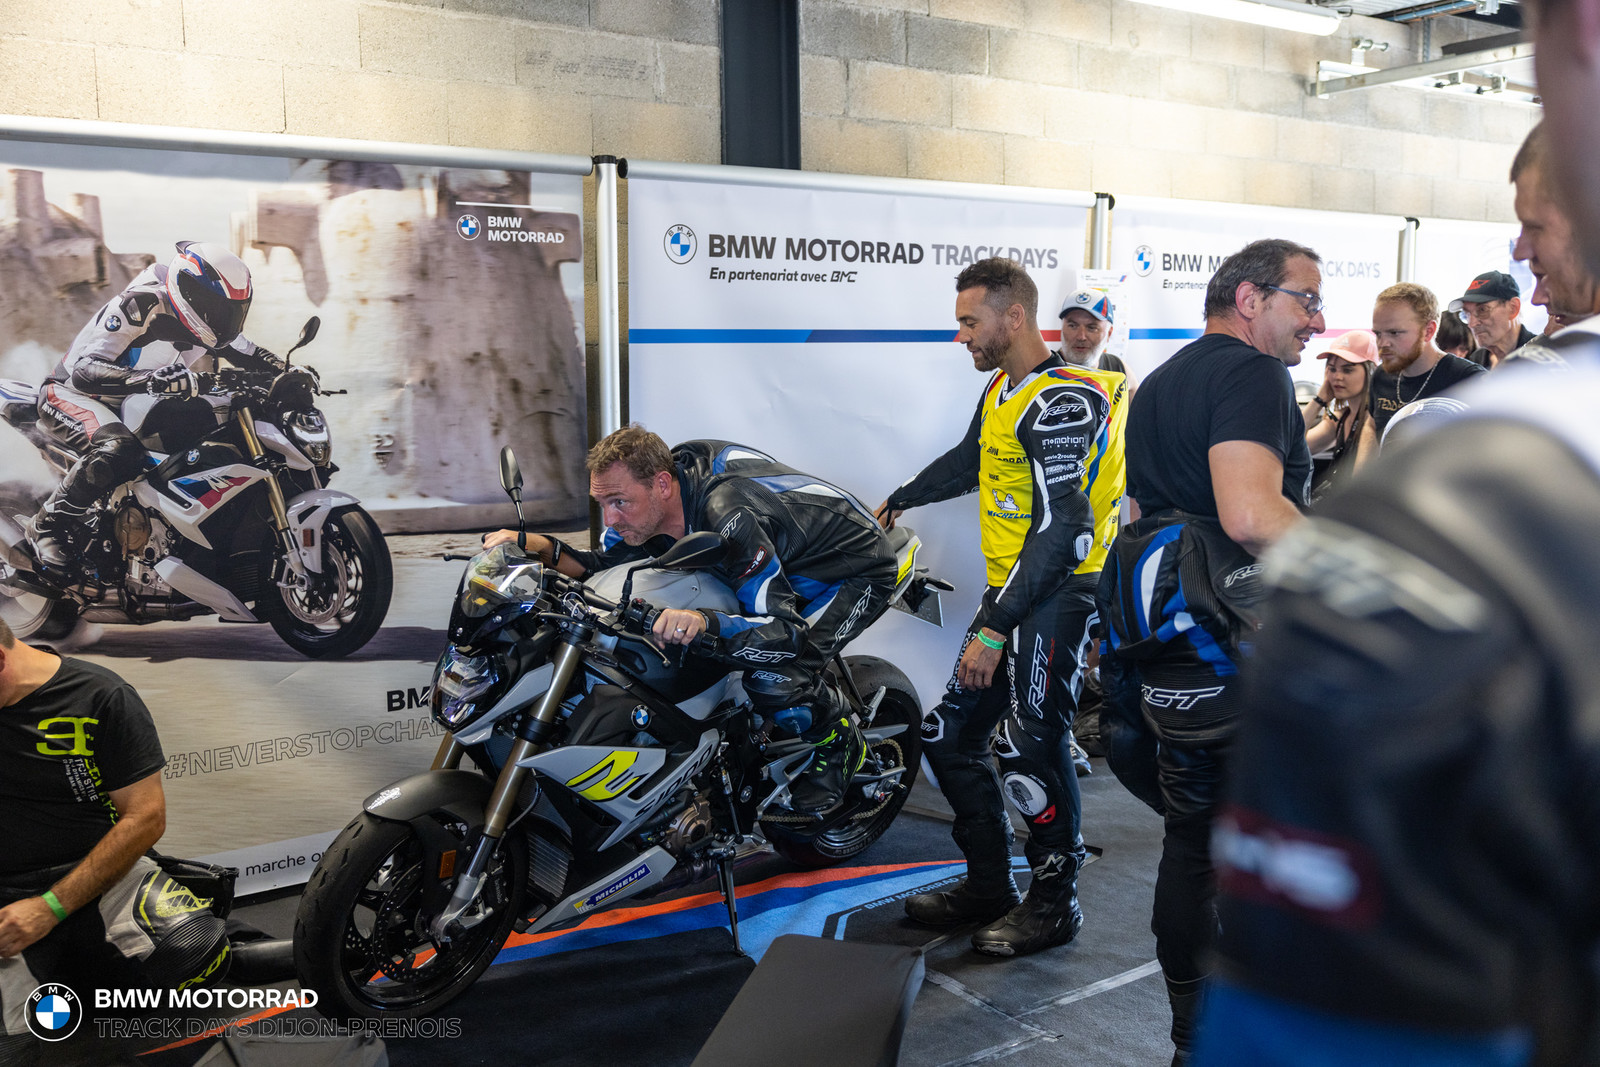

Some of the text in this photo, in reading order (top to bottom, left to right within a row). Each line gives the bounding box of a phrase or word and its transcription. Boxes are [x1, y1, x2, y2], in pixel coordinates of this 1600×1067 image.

[488, 216, 522, 228] BMW
[488, 230, 565, 243] MOTORRAD
[709, 234, 777, 260] BMW
[785, 237, 924, 265] MOTORRAD
[1162, 253, 1202, 273] BMW
[1347, 262, 1380, 279] DAYS
[709, 267, 726, 280] En
[728, 269, 798, 284] partenariat
[800, 273, 827, 283] avec
[1040, 403, 1086, 421] RST
[831, 584, 872, 649] RST
[732, 646, 796, 663] RST
[751, 670, 792, 683] RST
[1028, 632, 1049, 719] RST
[387, 685, 430, 712] BM
[246, 855, 306, 876] marche
[595, 867, 646, 901] MICHELIN
[865, 896, 896, 910] BMW
